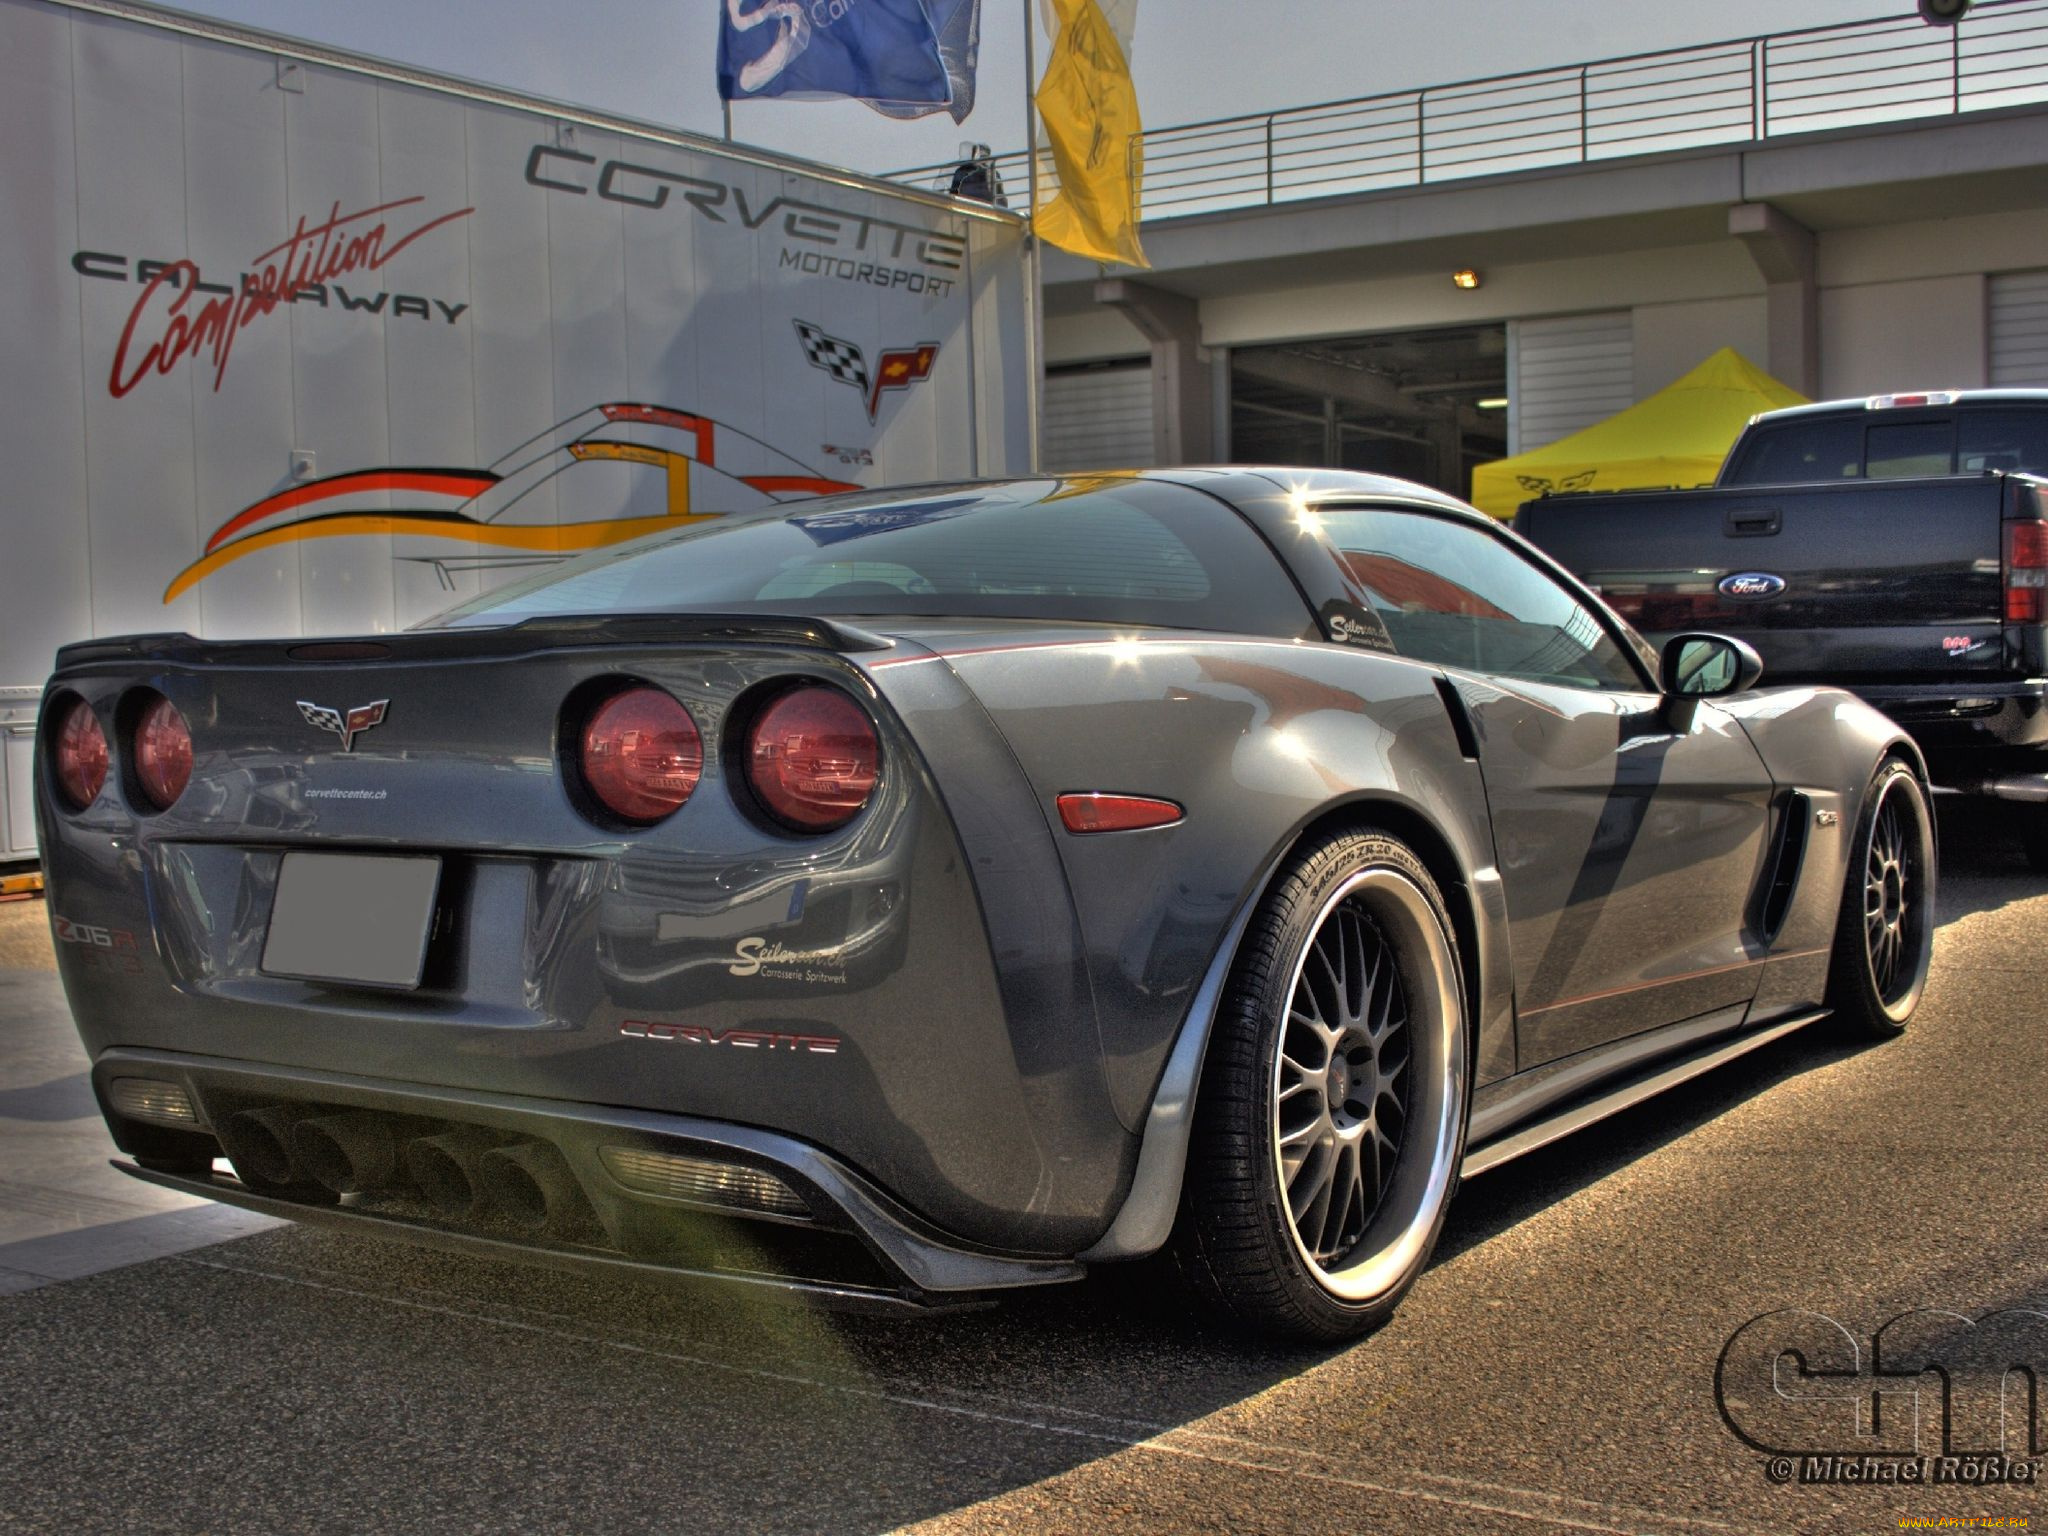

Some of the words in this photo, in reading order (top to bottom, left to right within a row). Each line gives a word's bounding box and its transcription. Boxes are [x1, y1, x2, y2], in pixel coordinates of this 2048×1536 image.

[525, 143, 967, 270] CORVETTE
[72, 250, 469, 325] CALLAWAY
[779, 247, 956, 299] MOTORSPORT
[109, 195, 475, 398] Competition
[304, 787, 388, 801] corvettecenter.ch
[54, 914, 139, 952] Z06R
[760, 965, 803, 981] Carrosserie
[805, 969, 847, 985] Spritzwerk
[620, 1019, 841, 1053] CORVETTE
